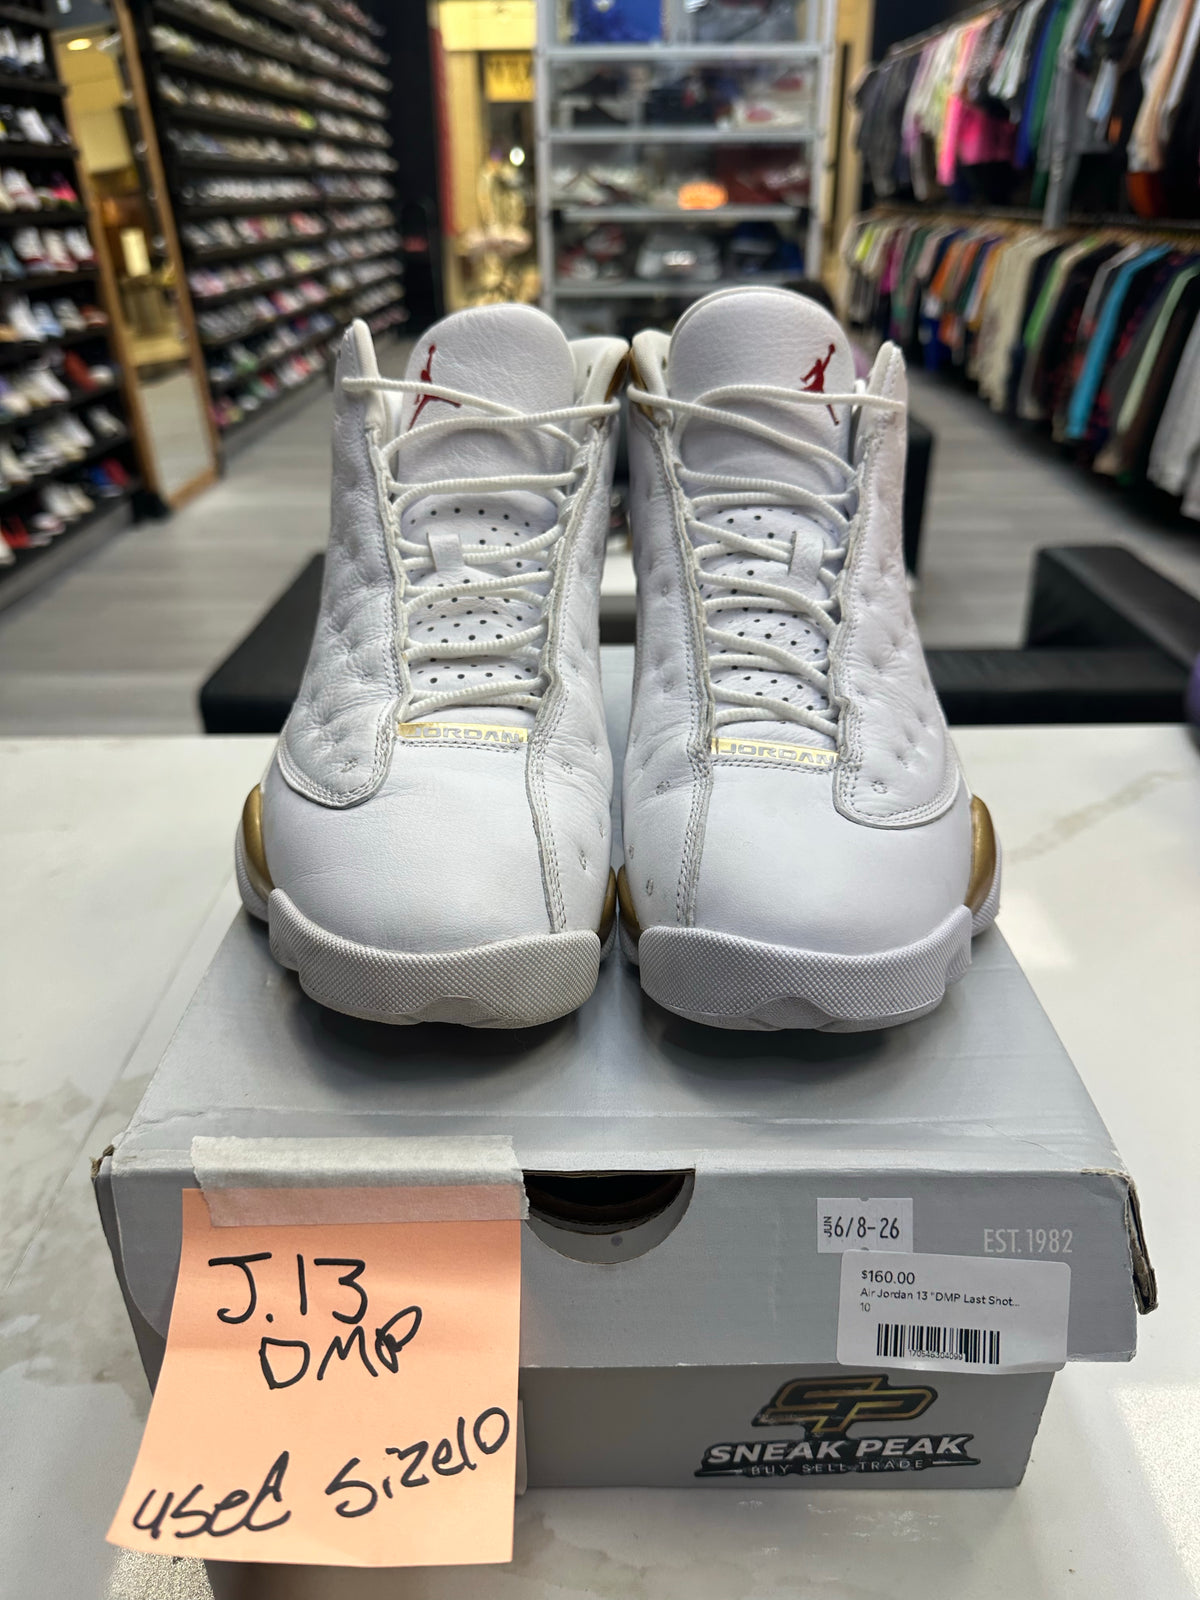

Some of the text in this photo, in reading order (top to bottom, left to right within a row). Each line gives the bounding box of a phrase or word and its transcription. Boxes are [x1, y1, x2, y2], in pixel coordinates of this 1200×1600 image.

[405, 726, 520, 744] JORDAN
[720, 743, 835, 766] JORDAN
[823, 1216, 833, 1238] JUN
[861, 1269, 916, 1285] $160.00
[860, 1287, 876, 1297] Air
[877, 1290, 914, 1300] Jordan
[917, 1291, 928, 1300] 13
[963, 1294, 987, 1305] Last
[860, 1302, 871, 1313] 10
[258, 1305, 423, 1390] DMP
[707, 1434, 972, 1464] SNEAK PEAK
[751, 1459, 924, 1476] BUY SELL TRADE
